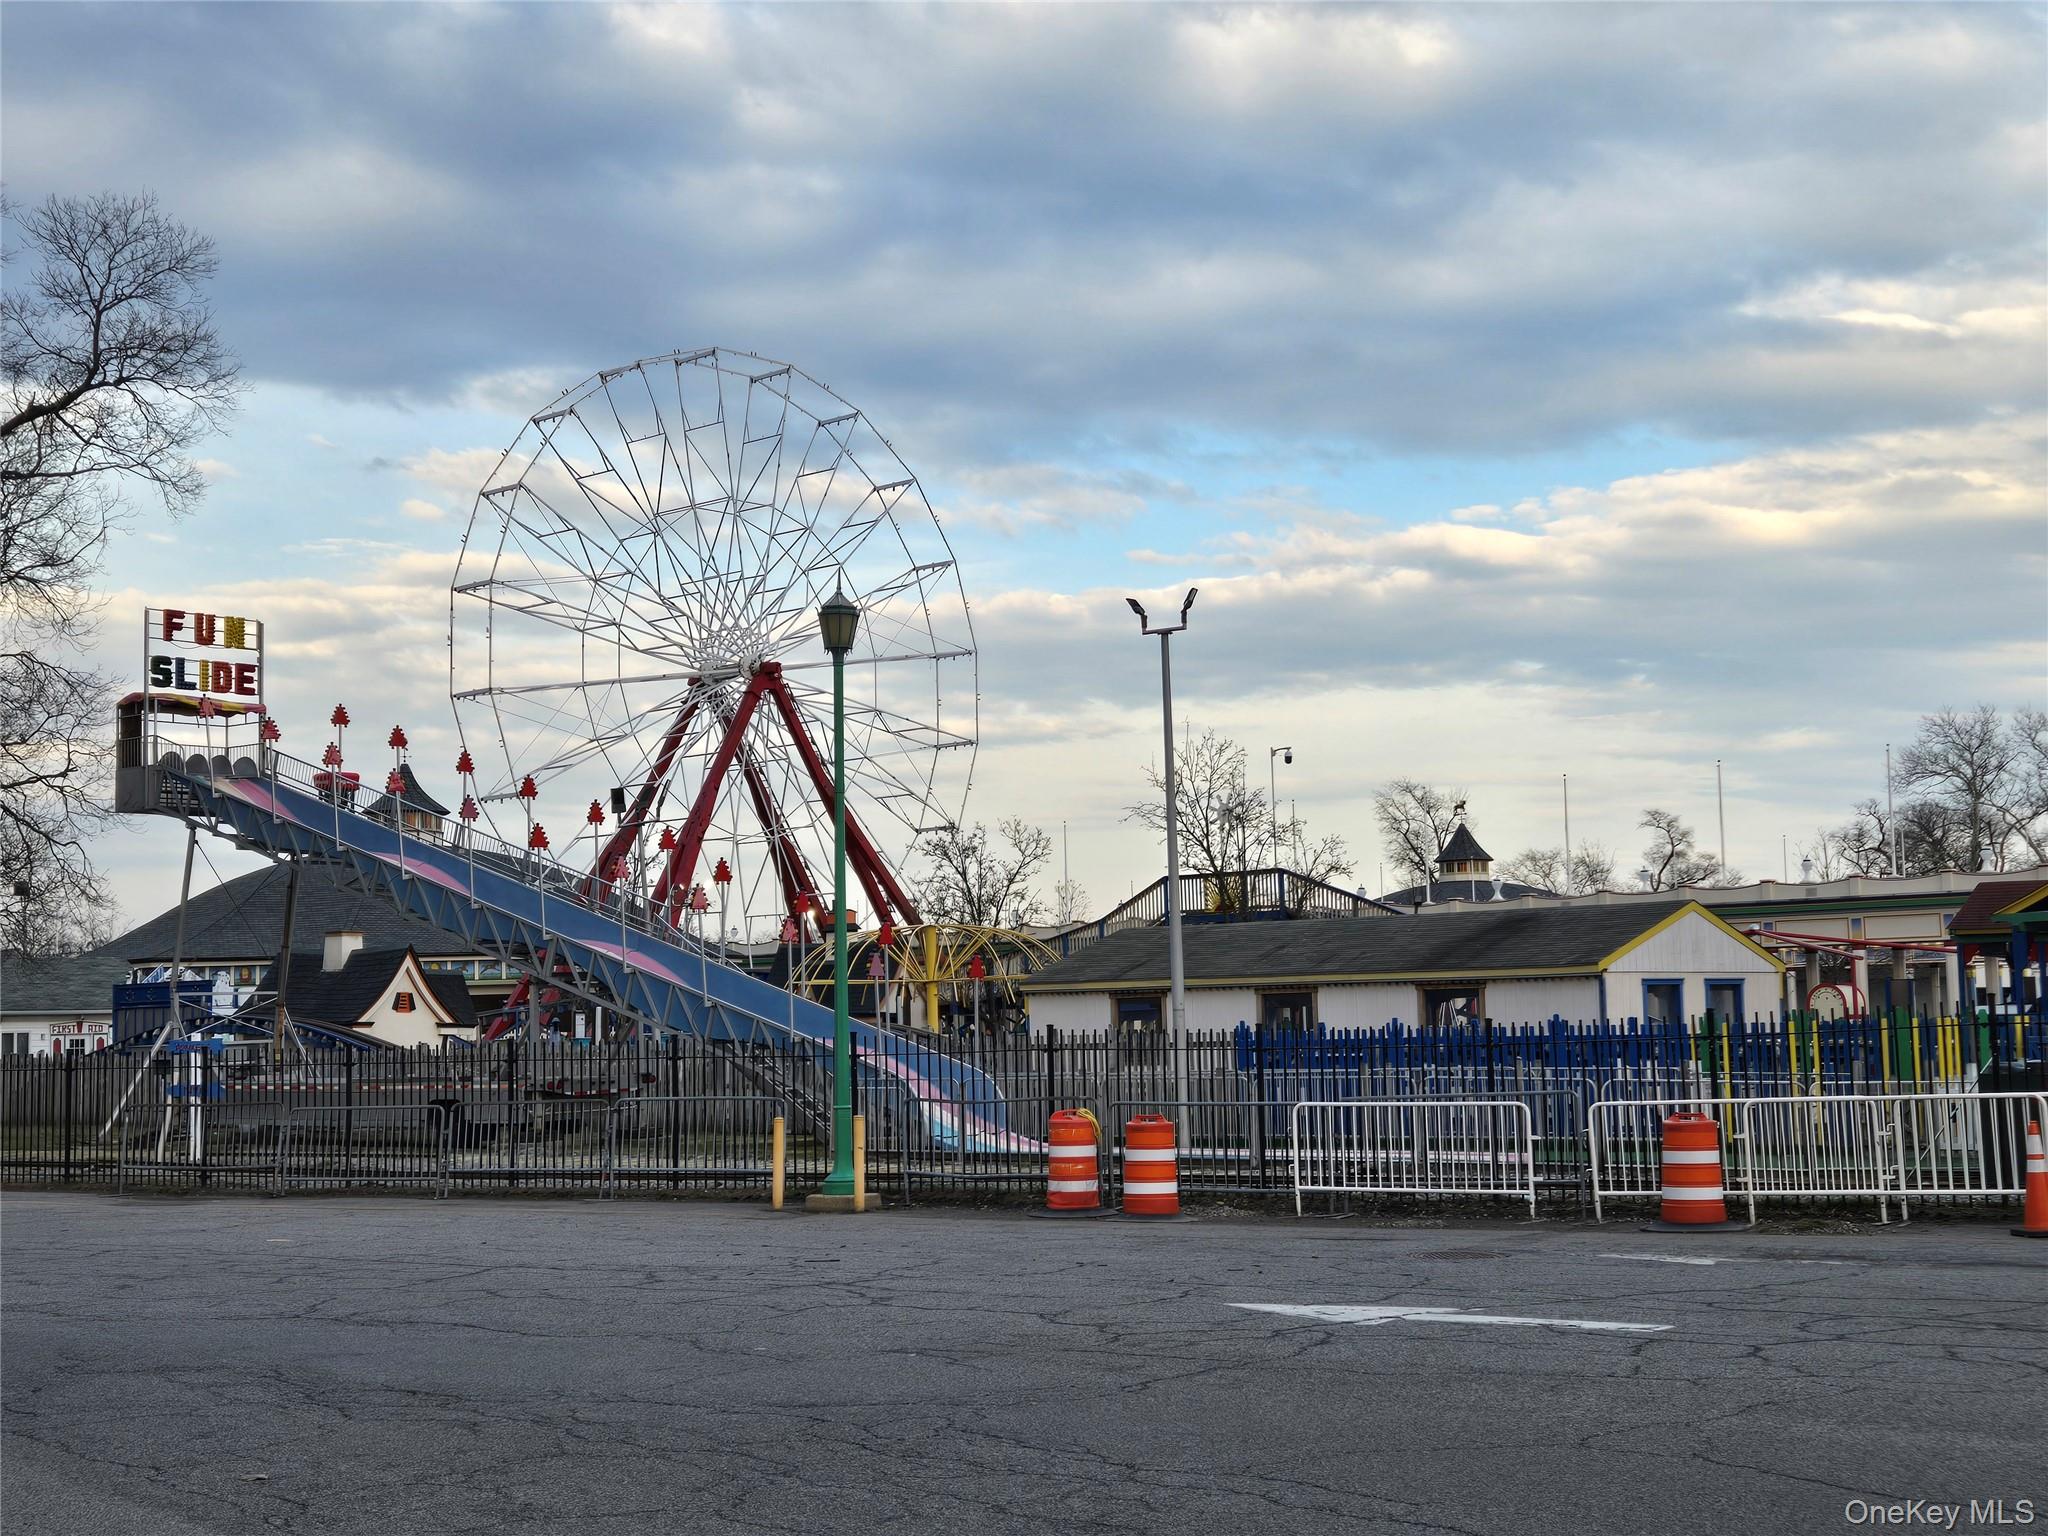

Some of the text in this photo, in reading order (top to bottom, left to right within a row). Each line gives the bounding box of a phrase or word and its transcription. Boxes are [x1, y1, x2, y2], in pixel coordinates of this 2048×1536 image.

[163, 609, 246, 649] FUN
[150, 655, 257, 696] SLIDE
[51, 1024, 104, 1034] FIRST AID
